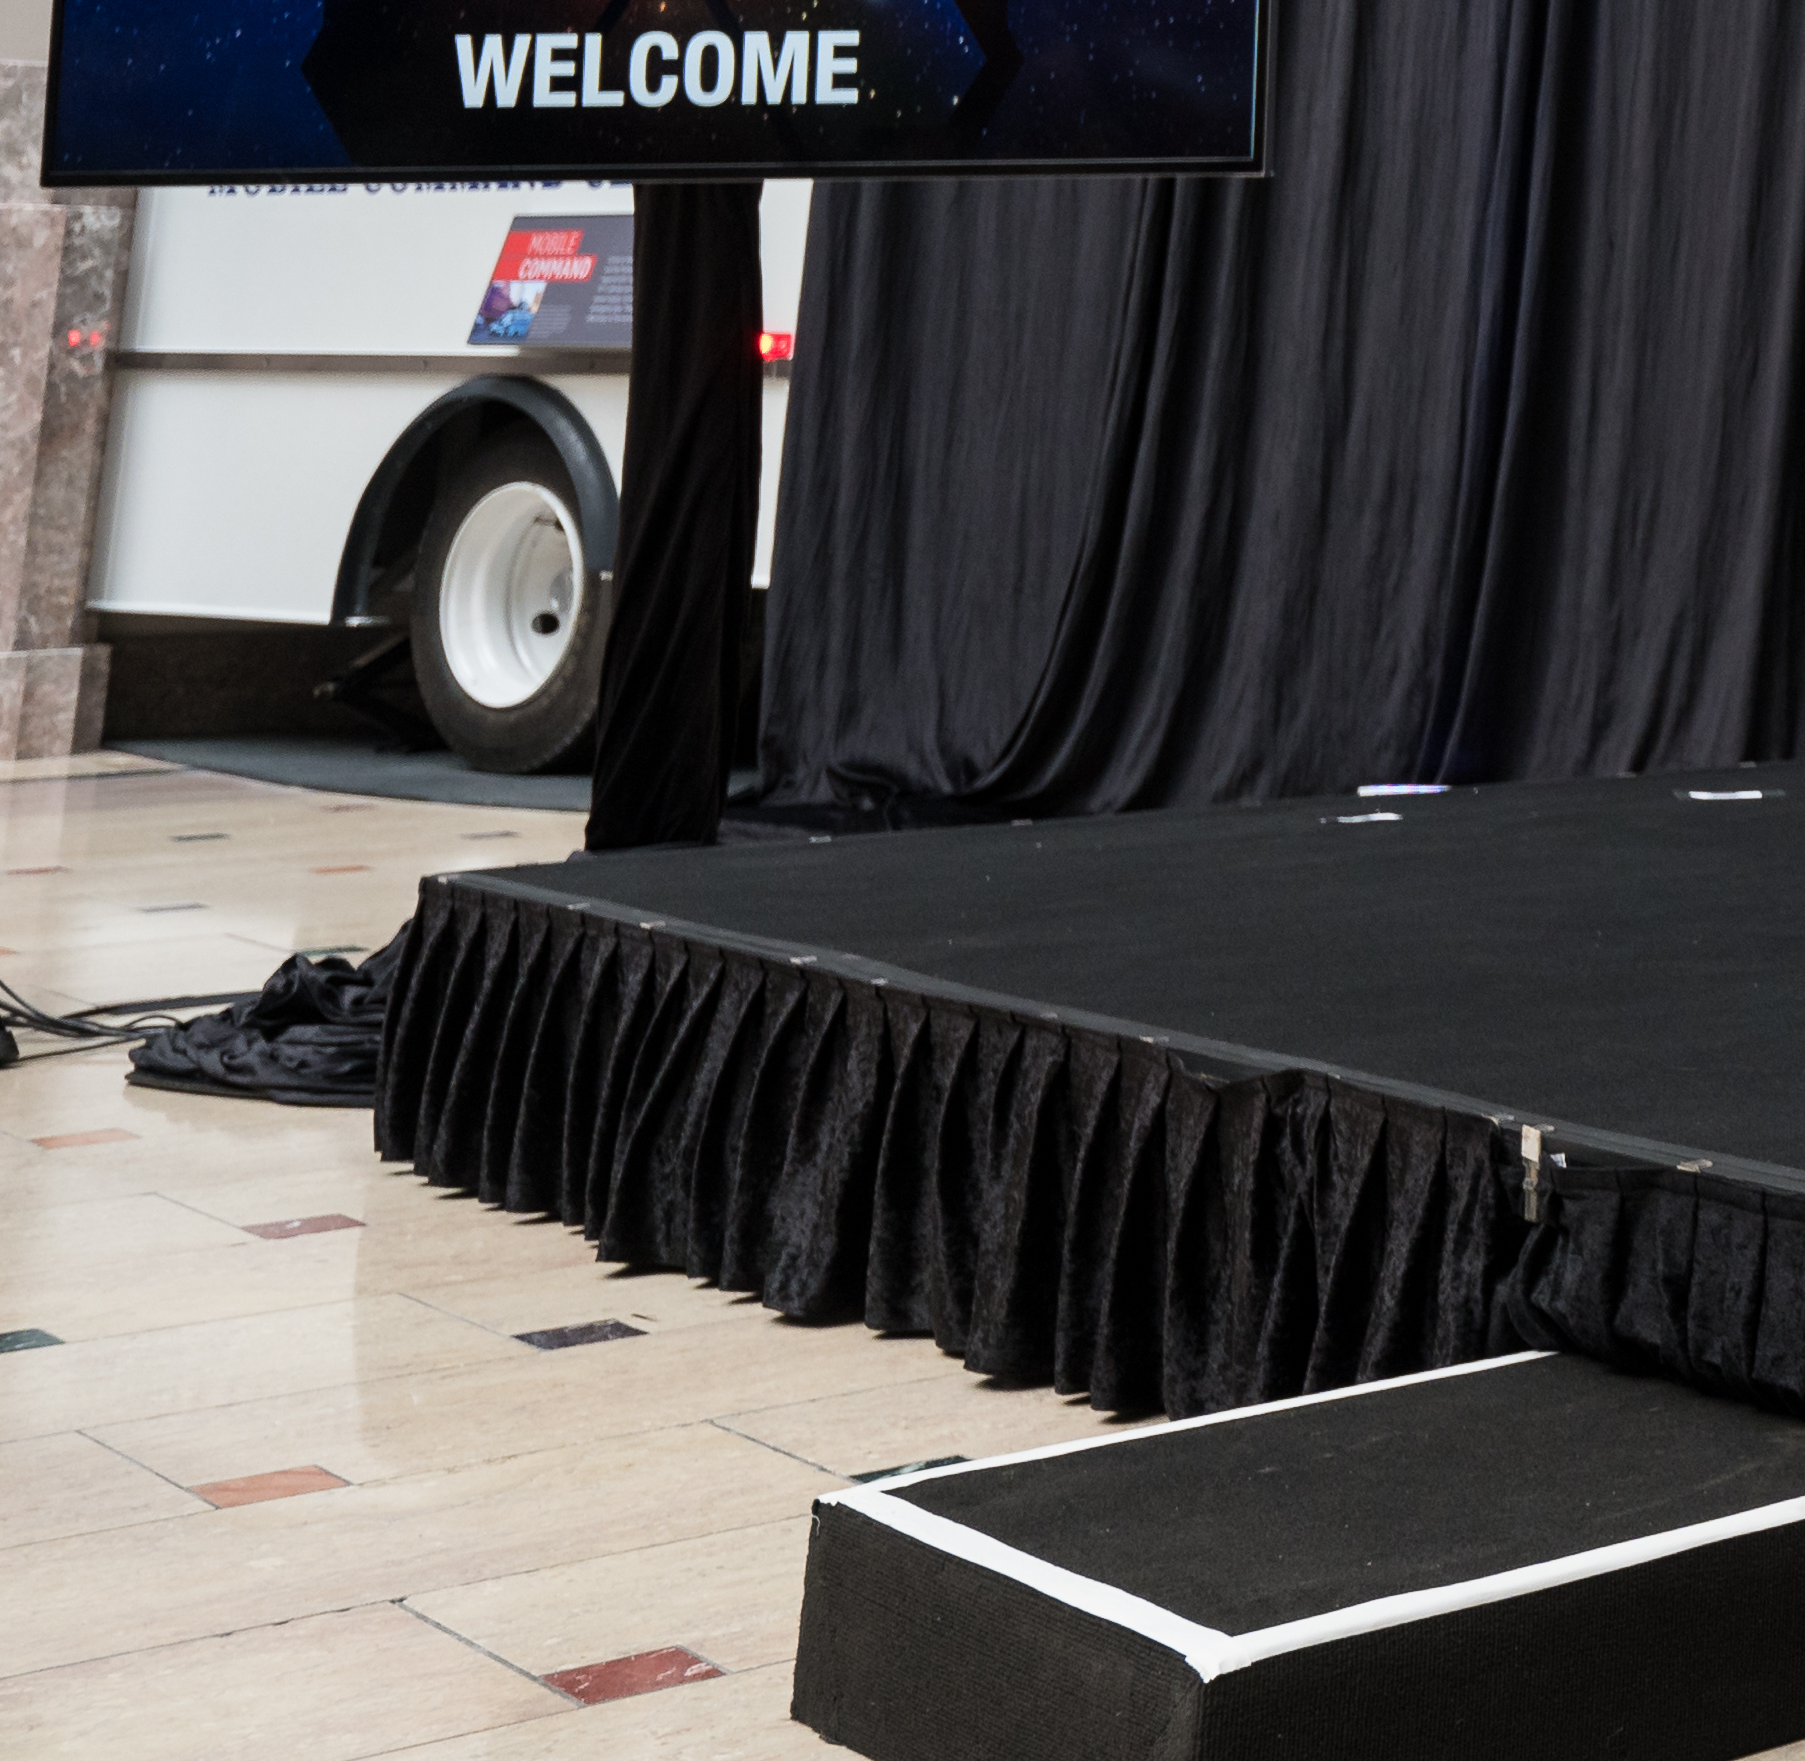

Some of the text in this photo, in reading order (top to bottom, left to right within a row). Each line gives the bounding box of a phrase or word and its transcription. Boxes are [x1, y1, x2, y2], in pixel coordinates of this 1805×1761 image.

[454, 29, 861, 109] WELCOME
[527, 231, 580, 255] MOBILE
[518, 257, 593, 280] COMMAND
